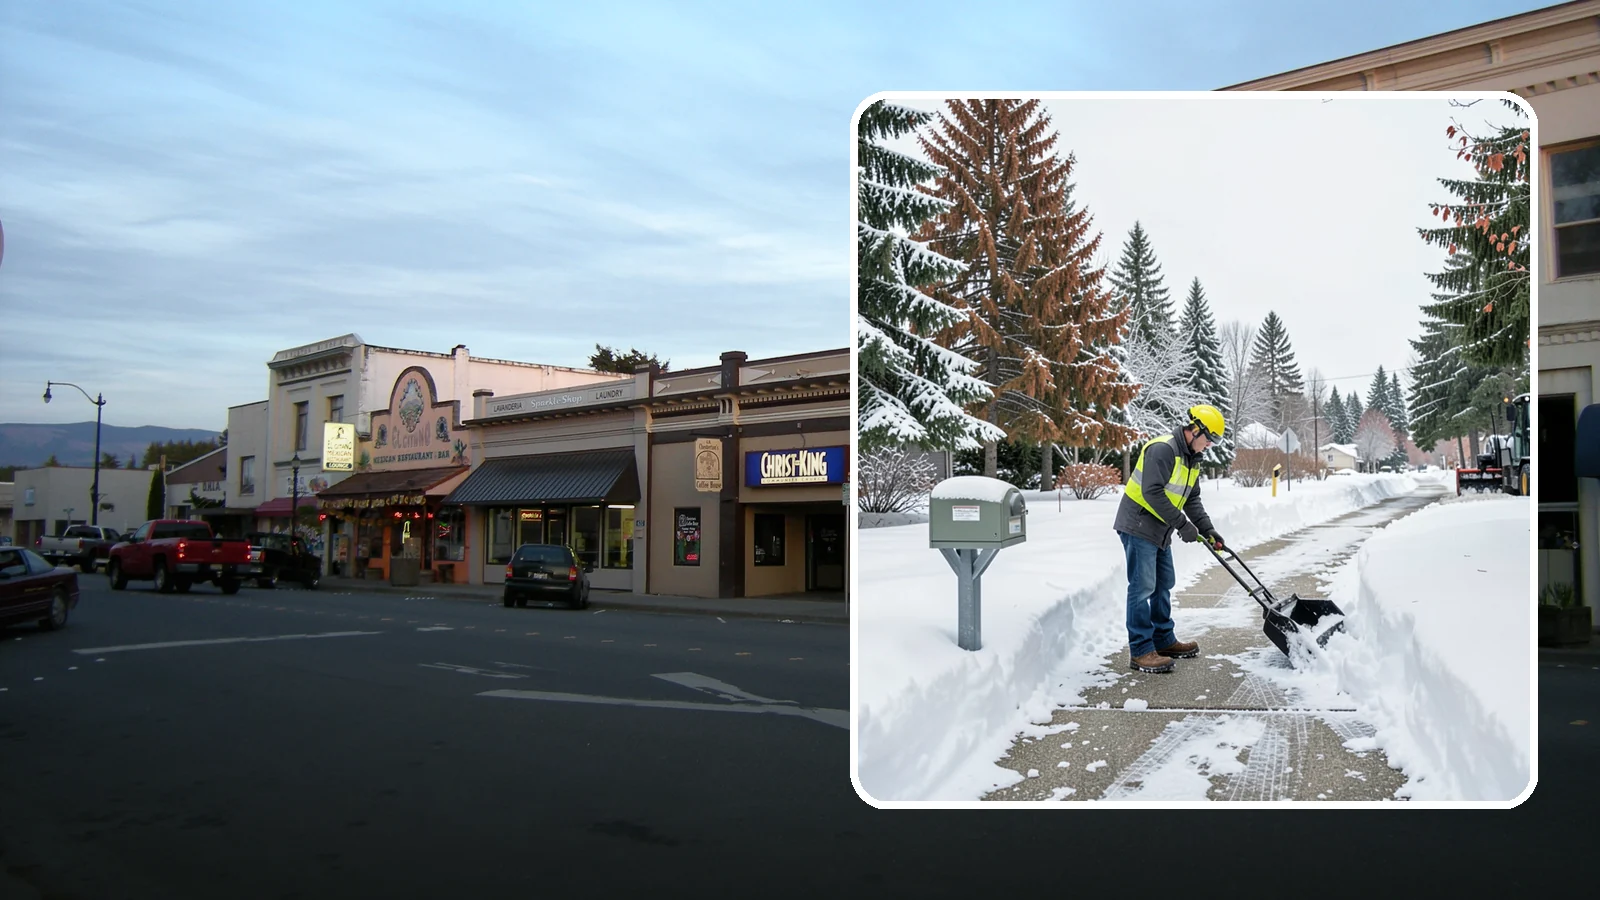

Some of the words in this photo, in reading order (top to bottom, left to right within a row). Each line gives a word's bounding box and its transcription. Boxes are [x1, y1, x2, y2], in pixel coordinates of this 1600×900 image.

[595, 389, 624, 400] LAUNDRY
[493, 402, 522, 413] LAVANDERIA
[530, 397, 561, 409] Sparkle
[561, 394, 583, 405] Shop
[373, 455, 396, 464] MEXICAN
[397, 451, 433, 462] RESTAURANT
[437, 450, 450, 459] BAR
[761, 452, 797, 478] CHRIST
[799, 450, 827, 476] KING
[696, 480, 709, 489] Coffee
